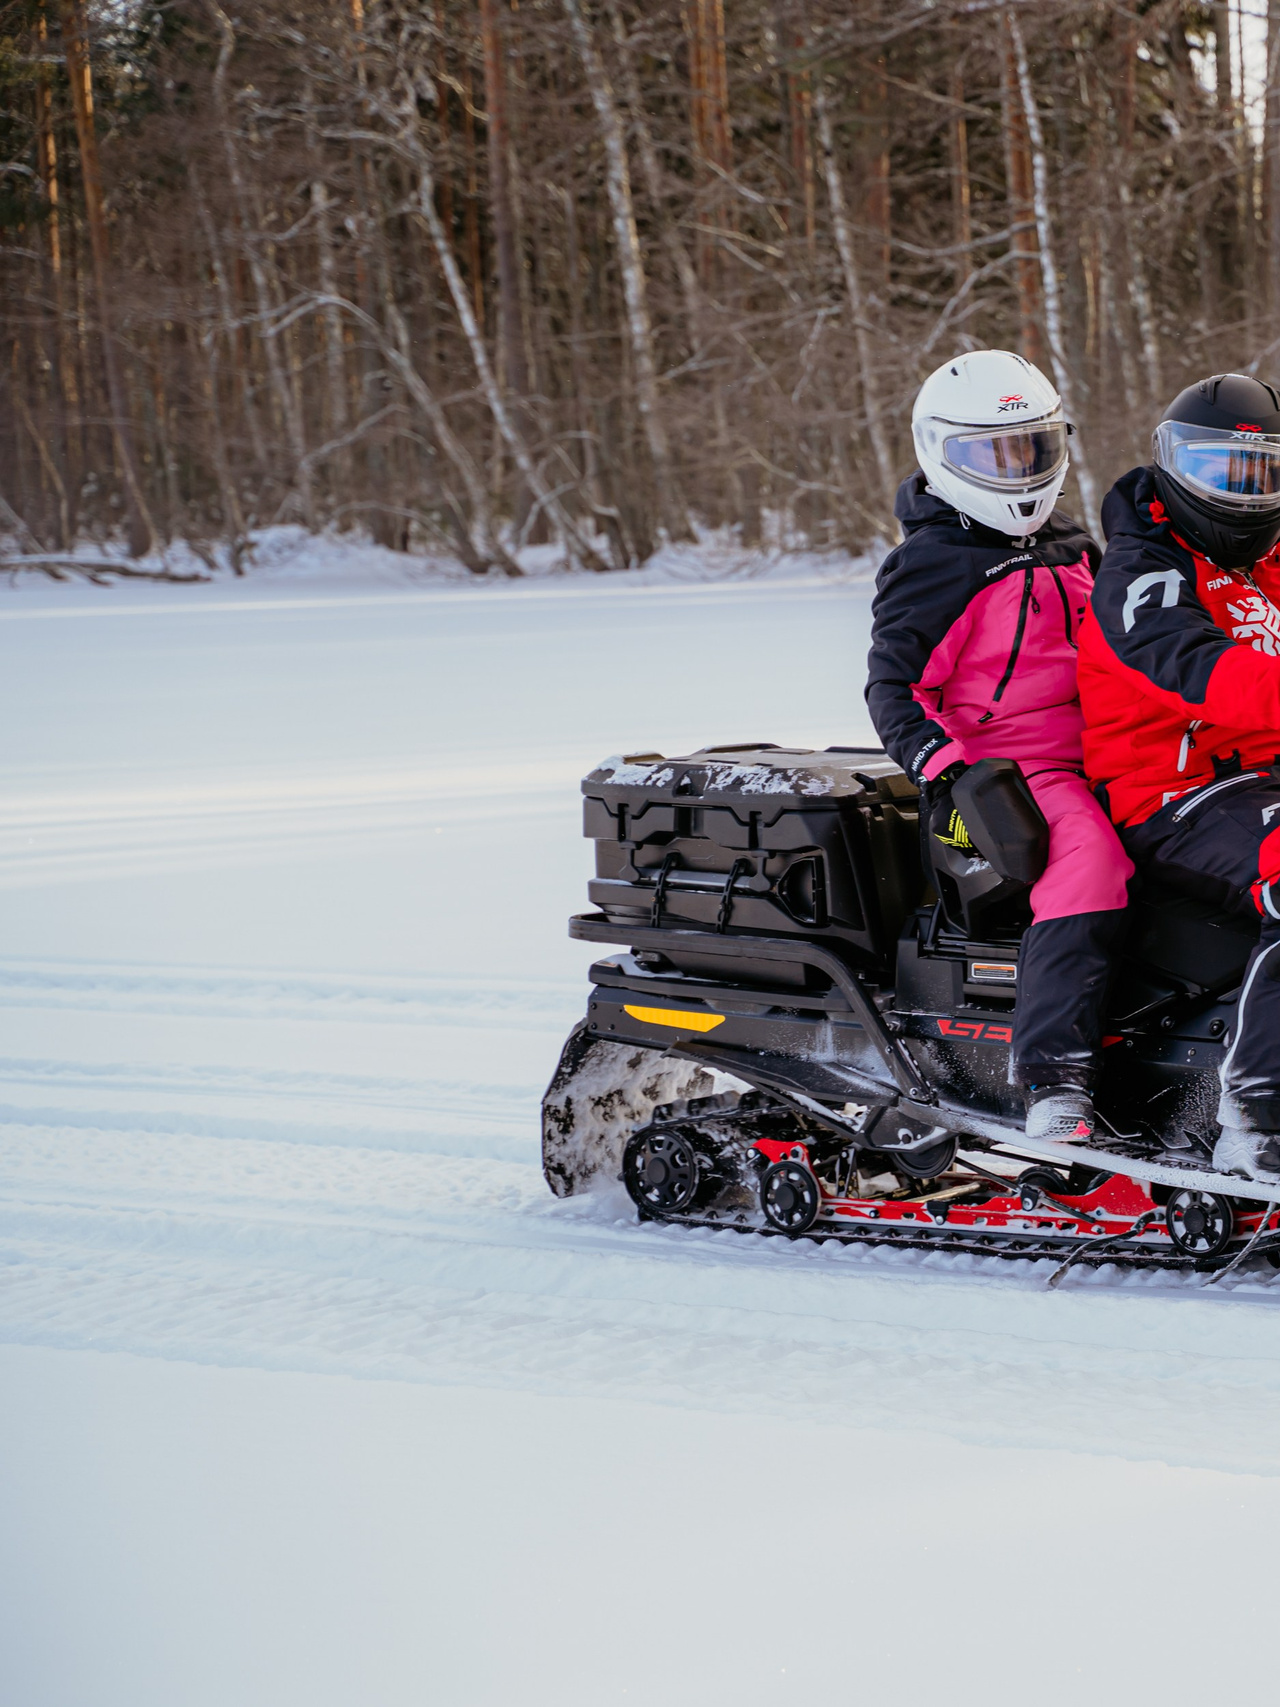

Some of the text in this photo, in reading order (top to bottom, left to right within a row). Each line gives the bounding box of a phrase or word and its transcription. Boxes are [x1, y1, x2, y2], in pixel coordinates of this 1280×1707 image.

[997, 401, 1029, 414] XTR
[985, 554, 1033, 577] FINNTRAIL
[911, 738, 939, 772] HARD-TEX
